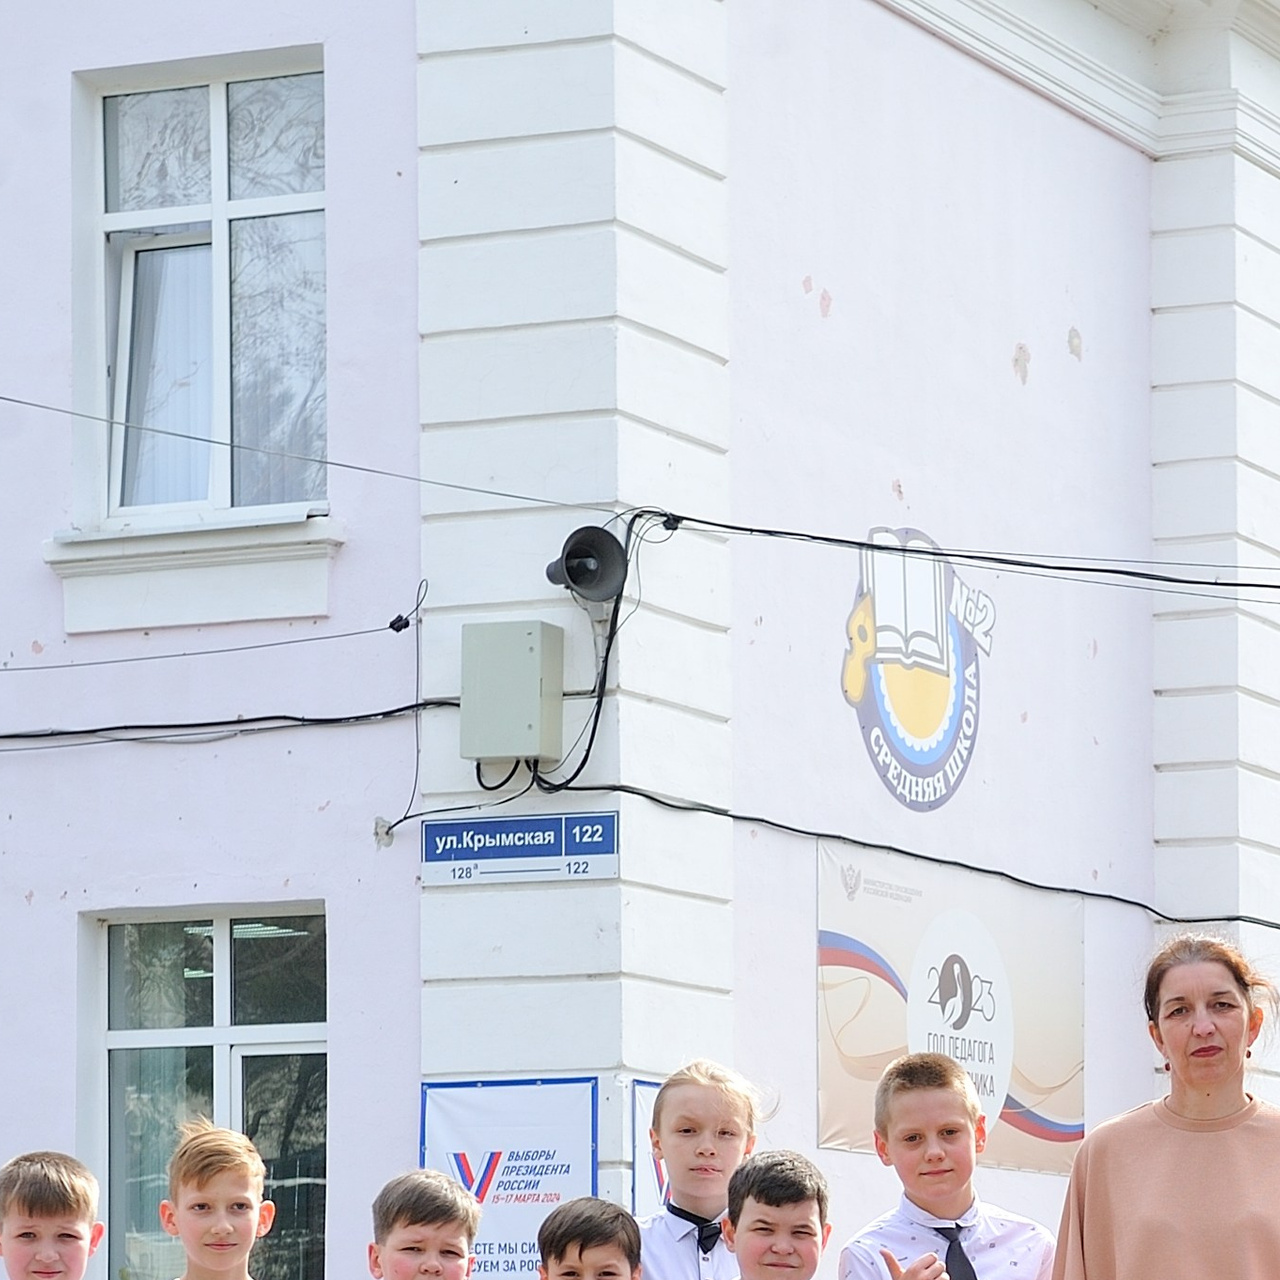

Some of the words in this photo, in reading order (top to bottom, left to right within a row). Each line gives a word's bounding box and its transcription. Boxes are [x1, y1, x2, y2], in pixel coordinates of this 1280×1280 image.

[949, 575, 997, 657] №2
[943, 661, 977, 787] ШКОЛА
[869, 726, 947, 803] СРЕДНЯЯ
[435, 830, 555, 854] ул.Крымская
[572, 824, 603, 843] 122
[565, 861, 589, 875] 122
[949, 1036, 995, 1065] ПЕДАГОГА
[507, 1149, 557, 1162] ВЫБОРЫ
[501, 1163, 571, 1177] ПРЕЗИДЕНТА
[496, 1179, 541, 1191] РОССИИ
[513, 1193, 541, 1203] МАРТА
[541, 1192, 561, 1203] 2024
[498, 1242, 518, 1255] МЫ
[502, 1259, 517, 1272] ЗА
